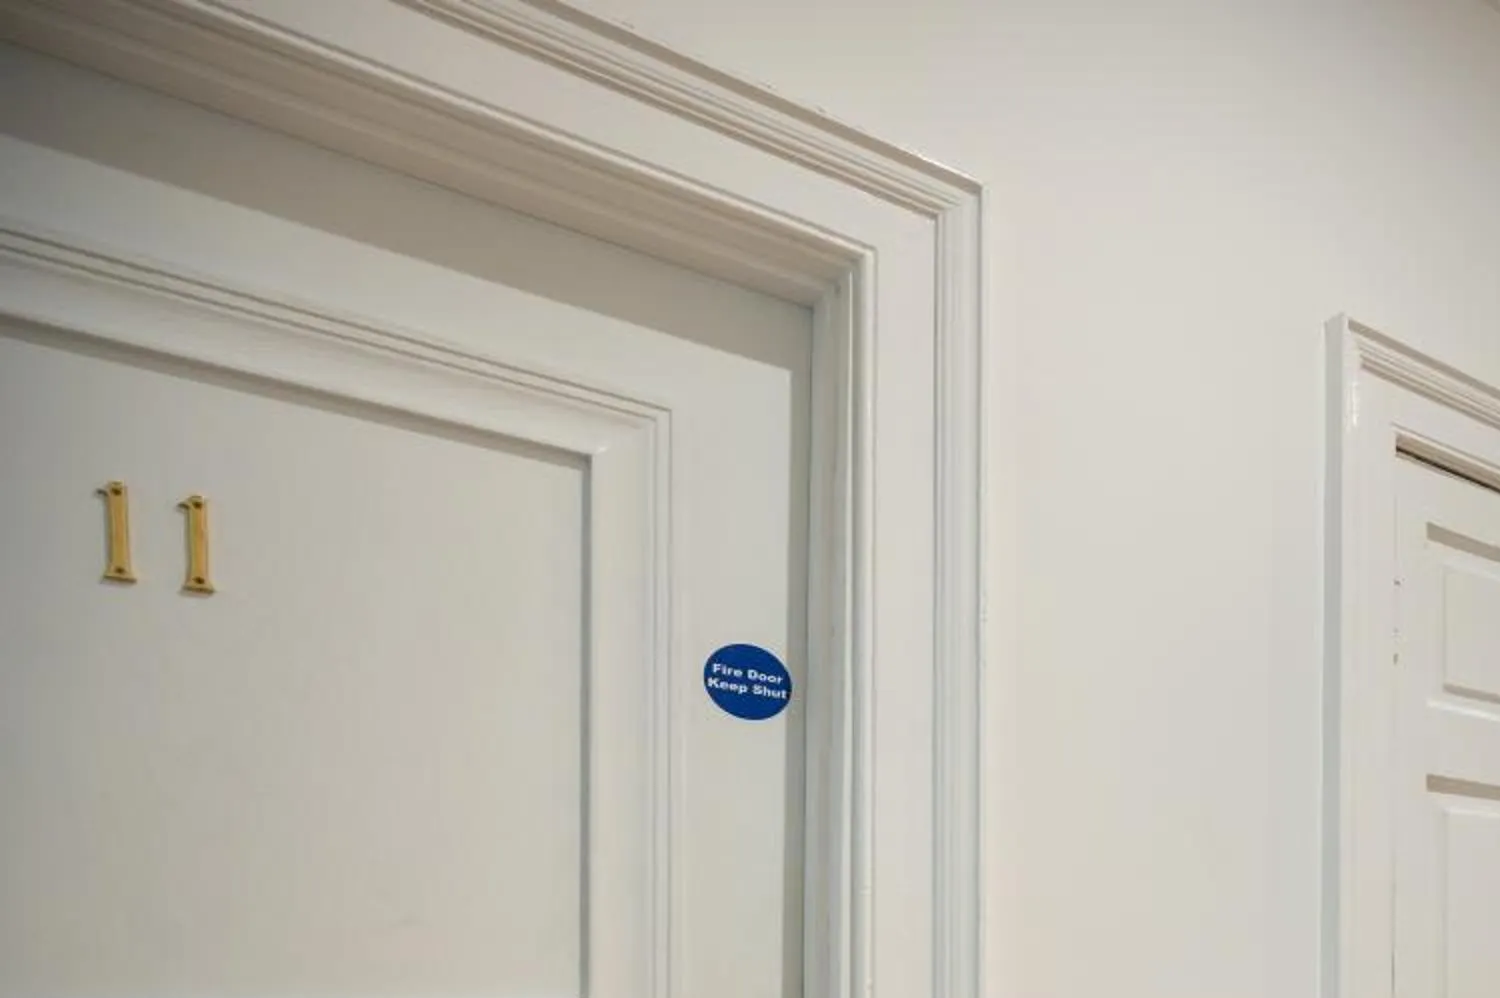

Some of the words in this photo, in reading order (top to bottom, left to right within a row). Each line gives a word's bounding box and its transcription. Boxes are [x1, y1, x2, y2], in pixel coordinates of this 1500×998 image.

[94, 480, 215, 595] 11
[712, 663, 743, 677] Fire
[747, 669, 783, 684] Door
[707, 677, 748, 694] Keep
[752, 684, 787, 698] Shut
